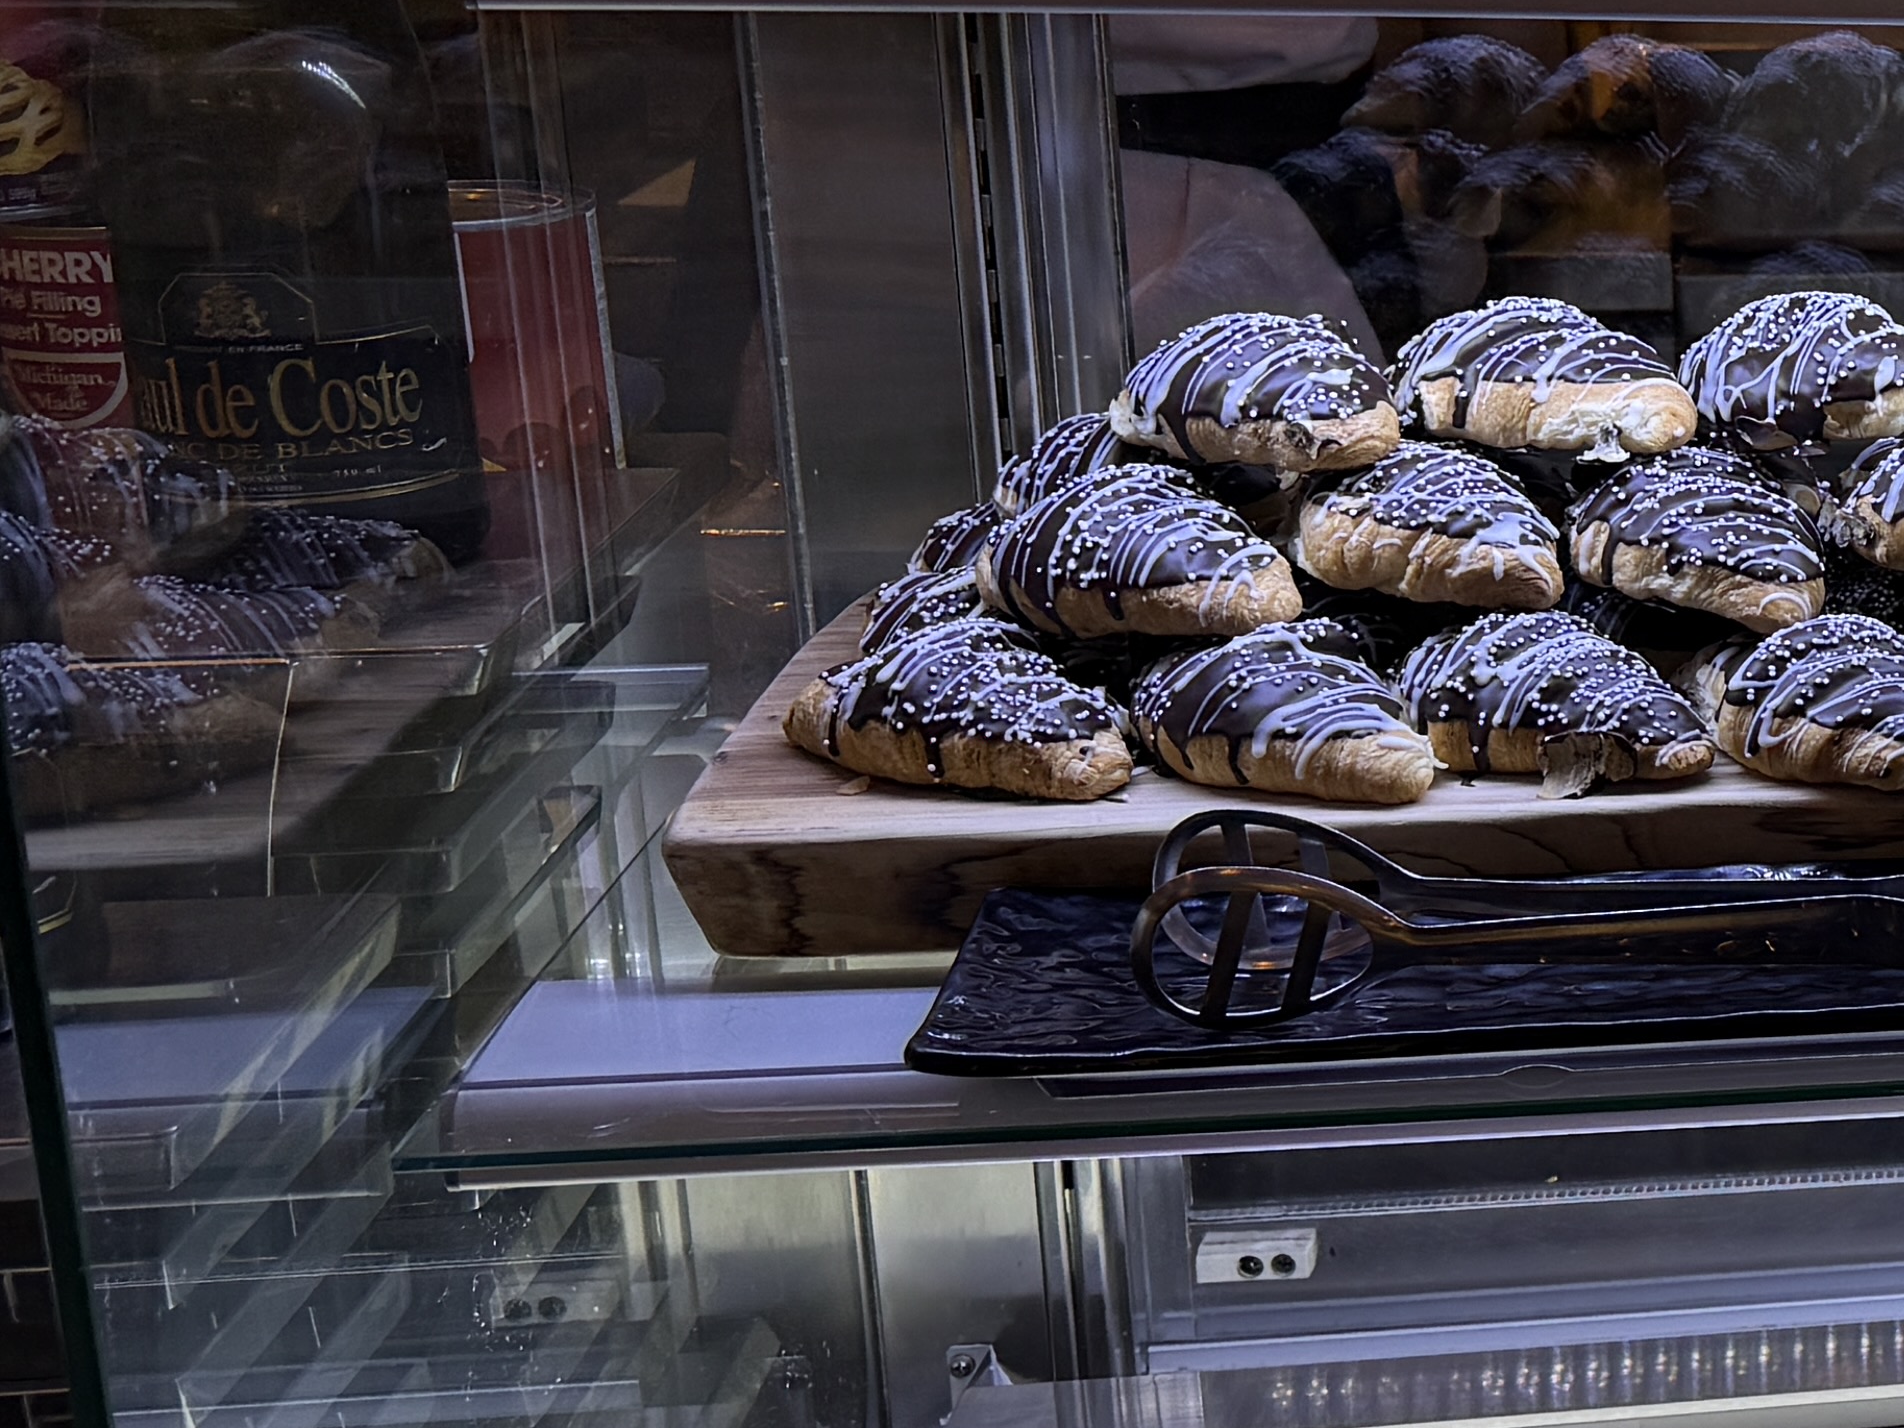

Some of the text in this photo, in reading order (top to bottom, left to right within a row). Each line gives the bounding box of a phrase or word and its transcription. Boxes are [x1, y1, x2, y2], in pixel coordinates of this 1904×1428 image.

[31, 291, 102, 317] Filling
[195, 359, 259, 438] de
[267, 357, 423, 437] Coste
[218, 442, 261, 460] DE
[278, 428, 414, 459] BLANCS
